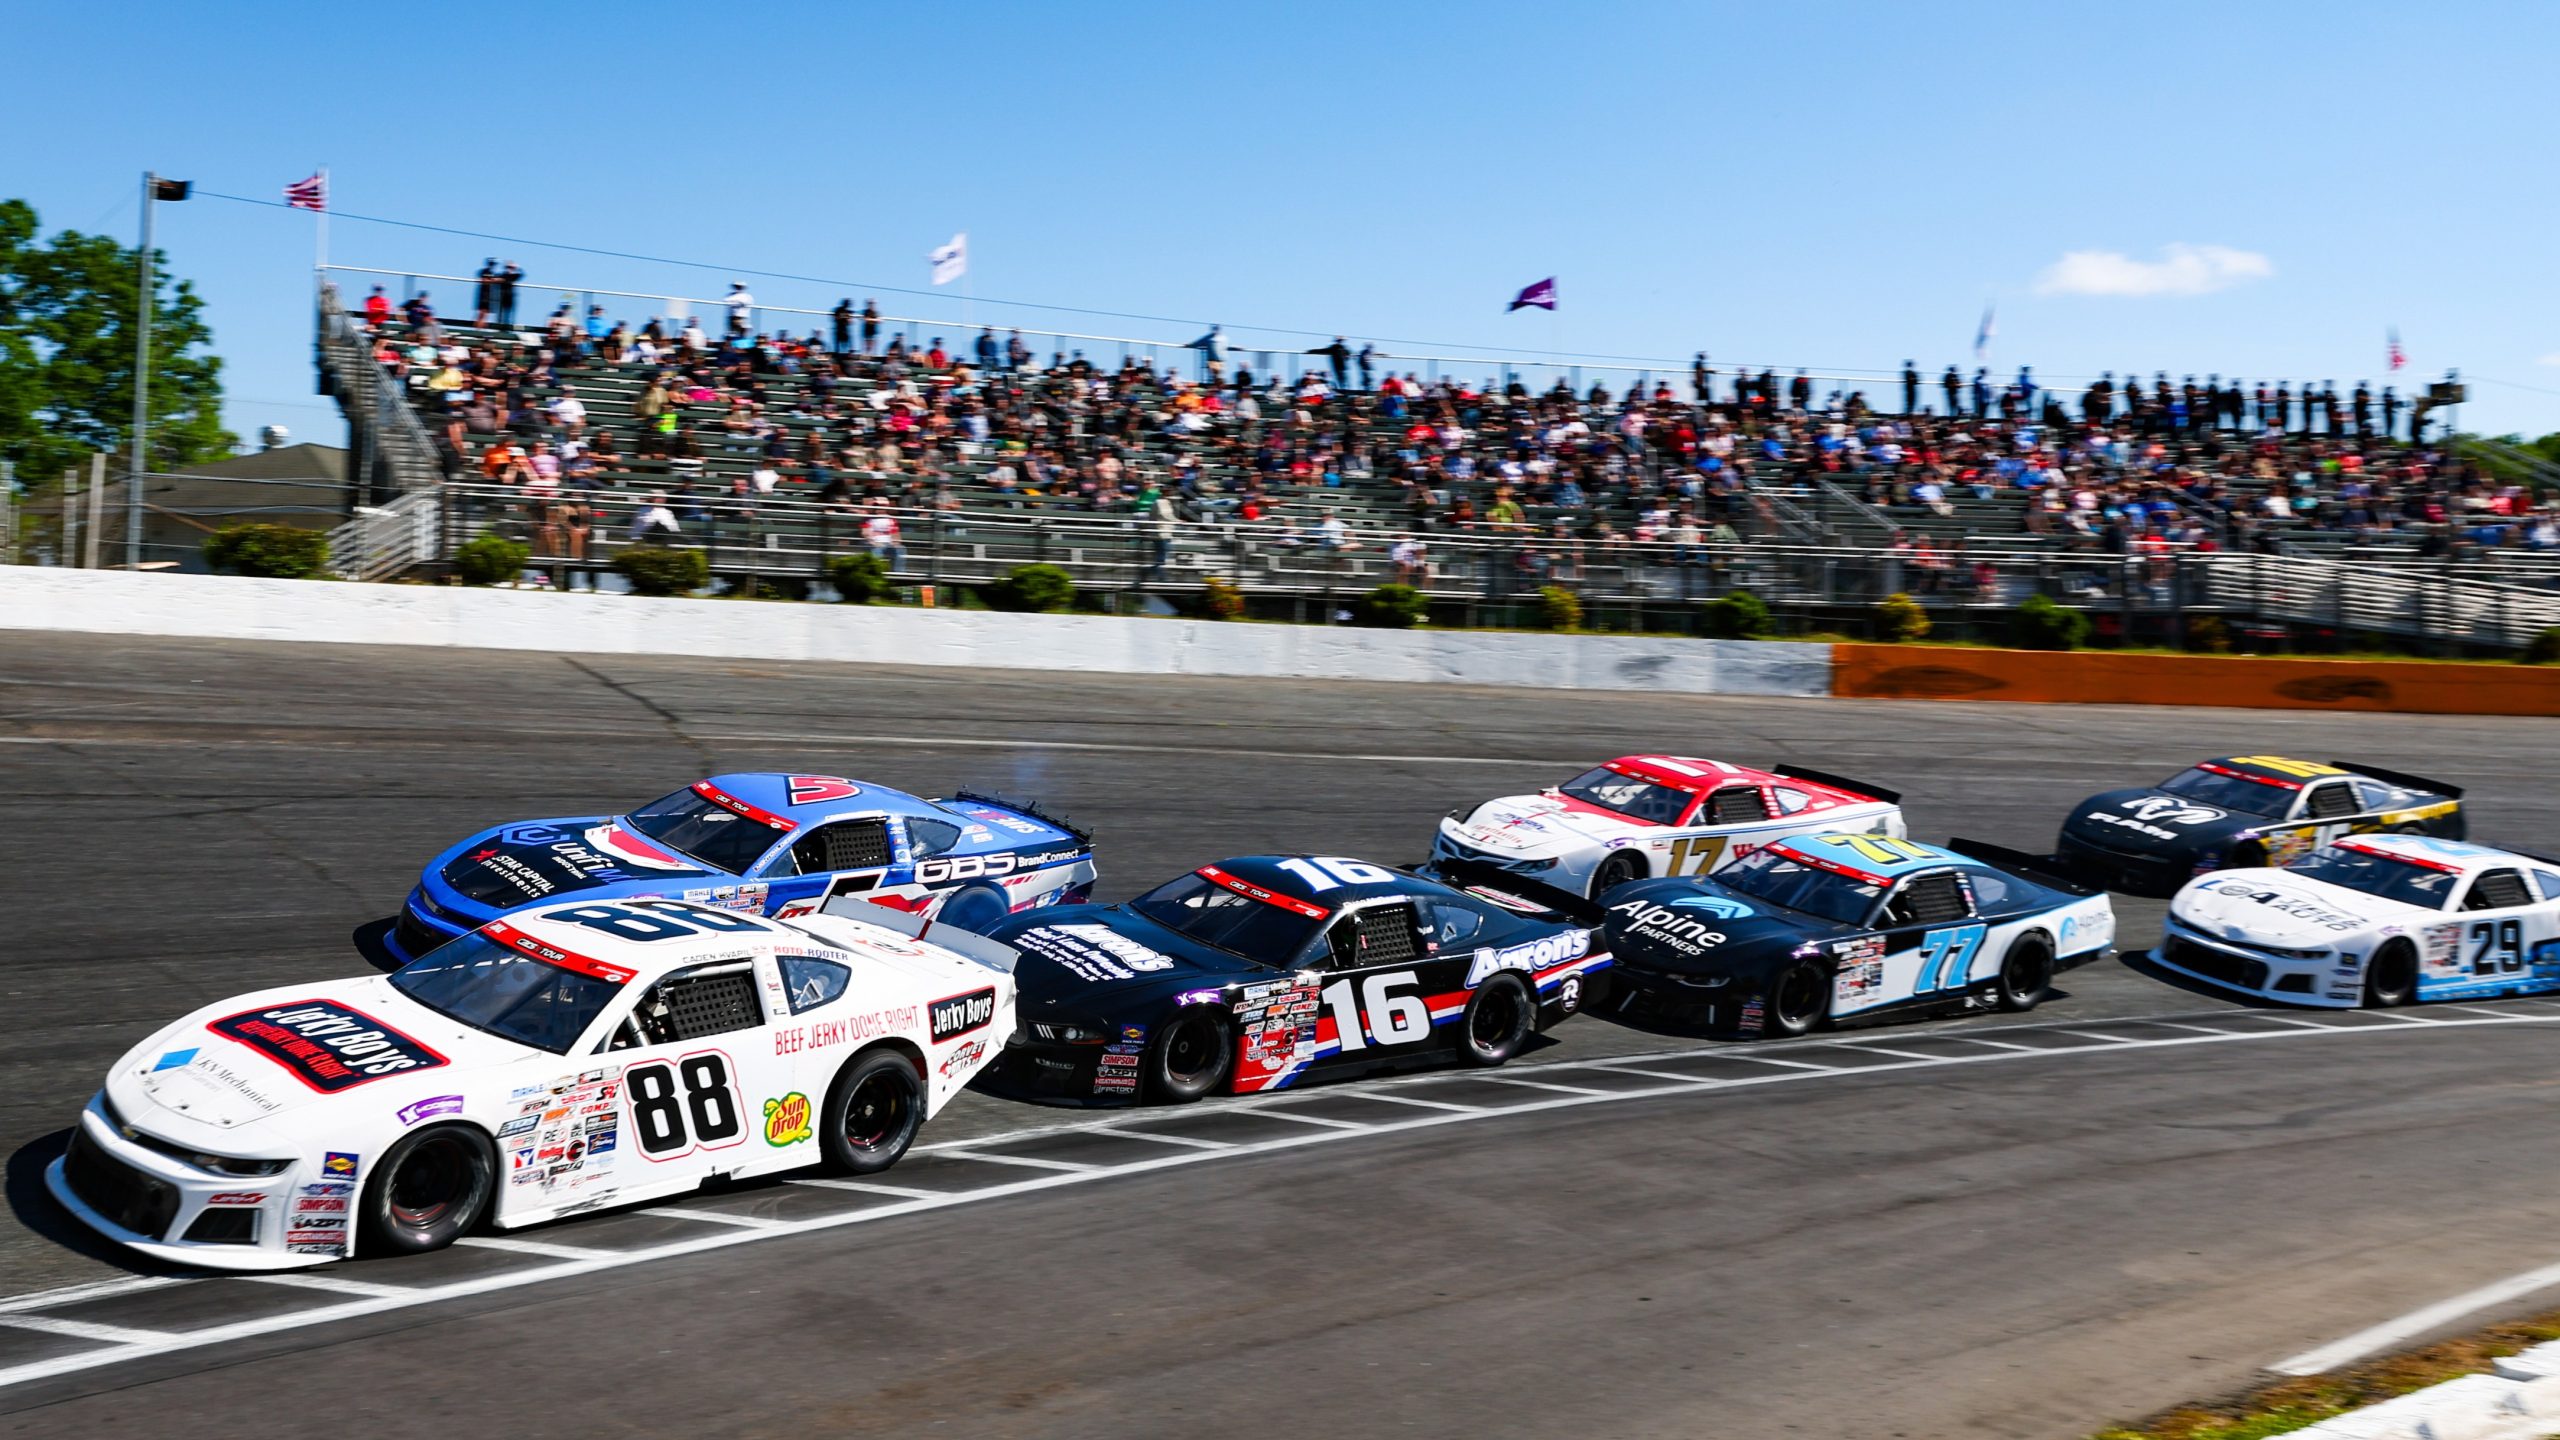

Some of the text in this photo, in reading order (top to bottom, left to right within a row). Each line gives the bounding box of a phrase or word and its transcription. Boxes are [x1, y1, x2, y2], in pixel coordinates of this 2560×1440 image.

[788, 776, 860, 805] 5
[2087, 812, 2179, 840] RAM
[1017, 849, 1080, 868] BrandConnect
[1668, 836, 1729, 877] 17
[1814, 834, 1945, 866] 77
[500, 855, 555, 894] STAR CAPITAL
[1275, 857, 1396, 892] 16
[1250, 889, 1270, 899] TOUR
[1610, 899, 1728, 949] Alpine
[1637, 924, 1705, 957] PARTNERS
[540, 947, 566, 961] TOUR
[773, 946, 849, 961] ROTO-ROOTER
[1464, 929, 1592, 989] Aaron's
[1913, 924, 1988, 995] 77
[2470, 918, 2522, 976] 29
[933, 996, 992, 1035] Jerky Boys
[1321, 971, 1430, 1051] 16
[263, 1007, 417, 1075] Jerky Boys
[775, 1005, 919, 1056] BEEF JERKY DONE RIGHT
[305, 1054, 352, 1080] RIGHT
[1103, 1055, 1137, 1065] SIMPSON
[218, 1069, 283, 1112] Mechanical
[626, 1054, 740, 1154] 88
[777, 1097, 806, 1118] Sun
[770, 1112, 803, 1140] Drop
[298, 1199, 345, 1211] SIMPSON
